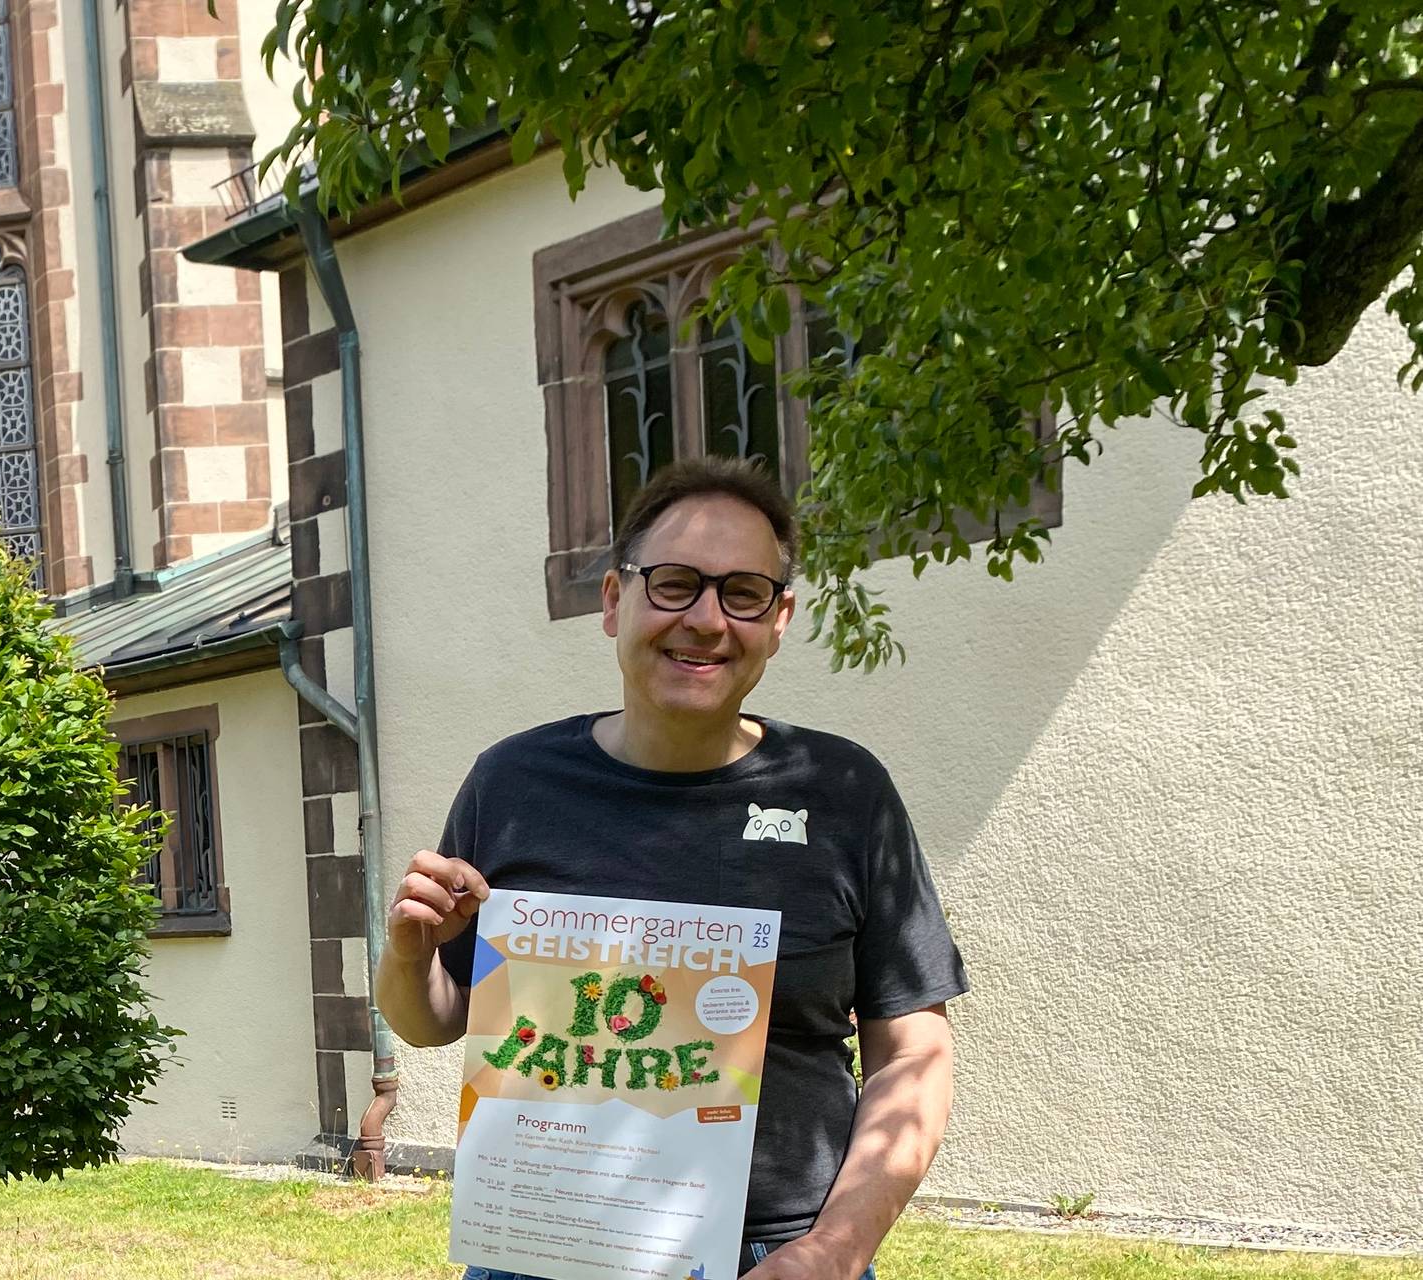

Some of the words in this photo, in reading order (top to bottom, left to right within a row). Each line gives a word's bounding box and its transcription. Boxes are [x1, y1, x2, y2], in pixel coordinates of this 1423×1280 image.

[512, 898, 743, 944] Sommergarten
[754, 922, 771, 936] 20
[507, 932, 740, 973] GEISTREICH
[752, 936, 769, 949] 25
[567, 971, 666, 1042] 10
[482, 1014, 720, 1091] JAHRE
[517, 1114, 587, 1134] Programm
